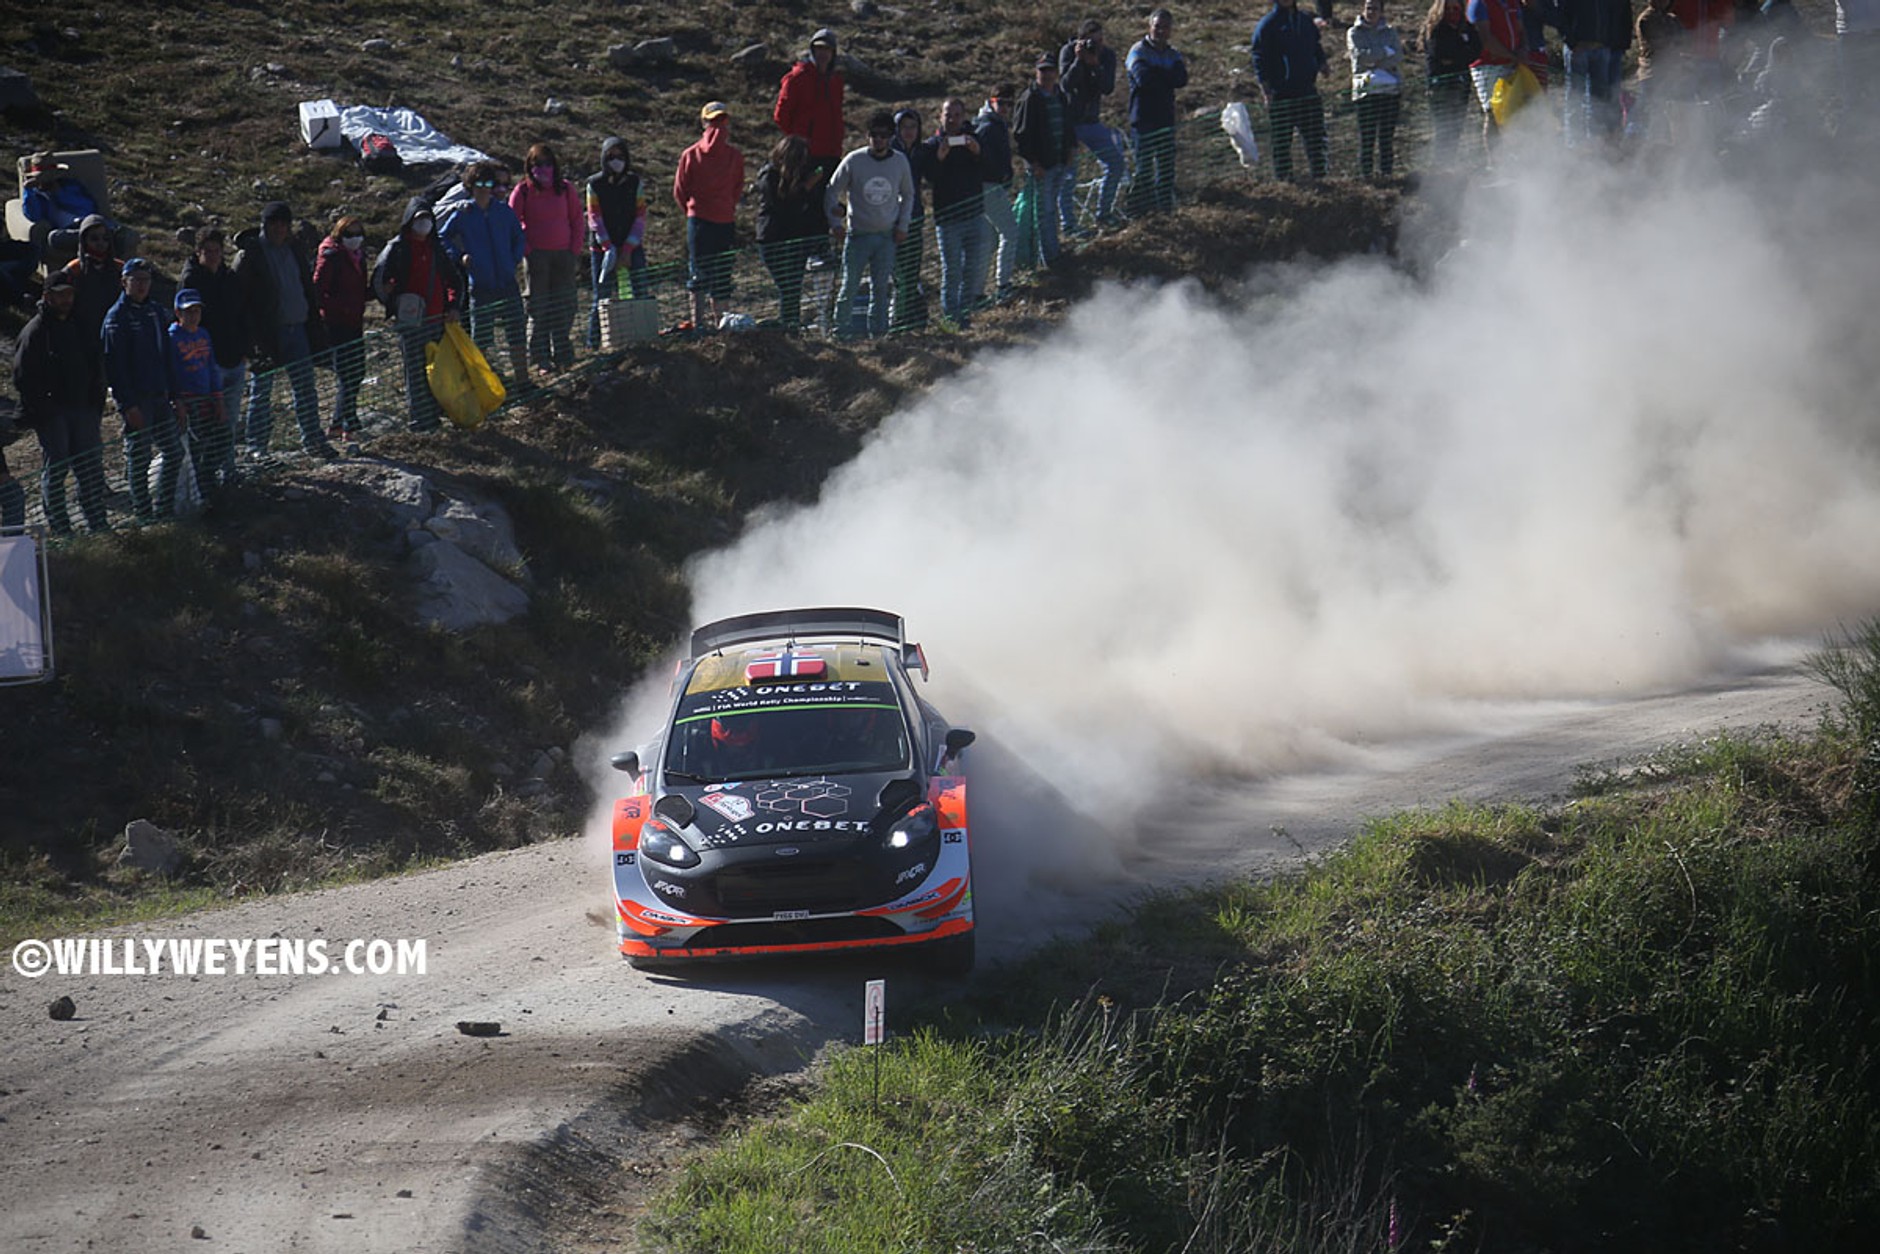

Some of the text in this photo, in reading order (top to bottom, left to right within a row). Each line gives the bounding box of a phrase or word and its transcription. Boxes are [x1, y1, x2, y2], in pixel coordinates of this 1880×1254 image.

[756, 682, 861, 695] ONEBET
[760, 698, 781, 706] Rally
[755, 820, 869, 834] ONEBET
[617, 853, 635, 866] DC
